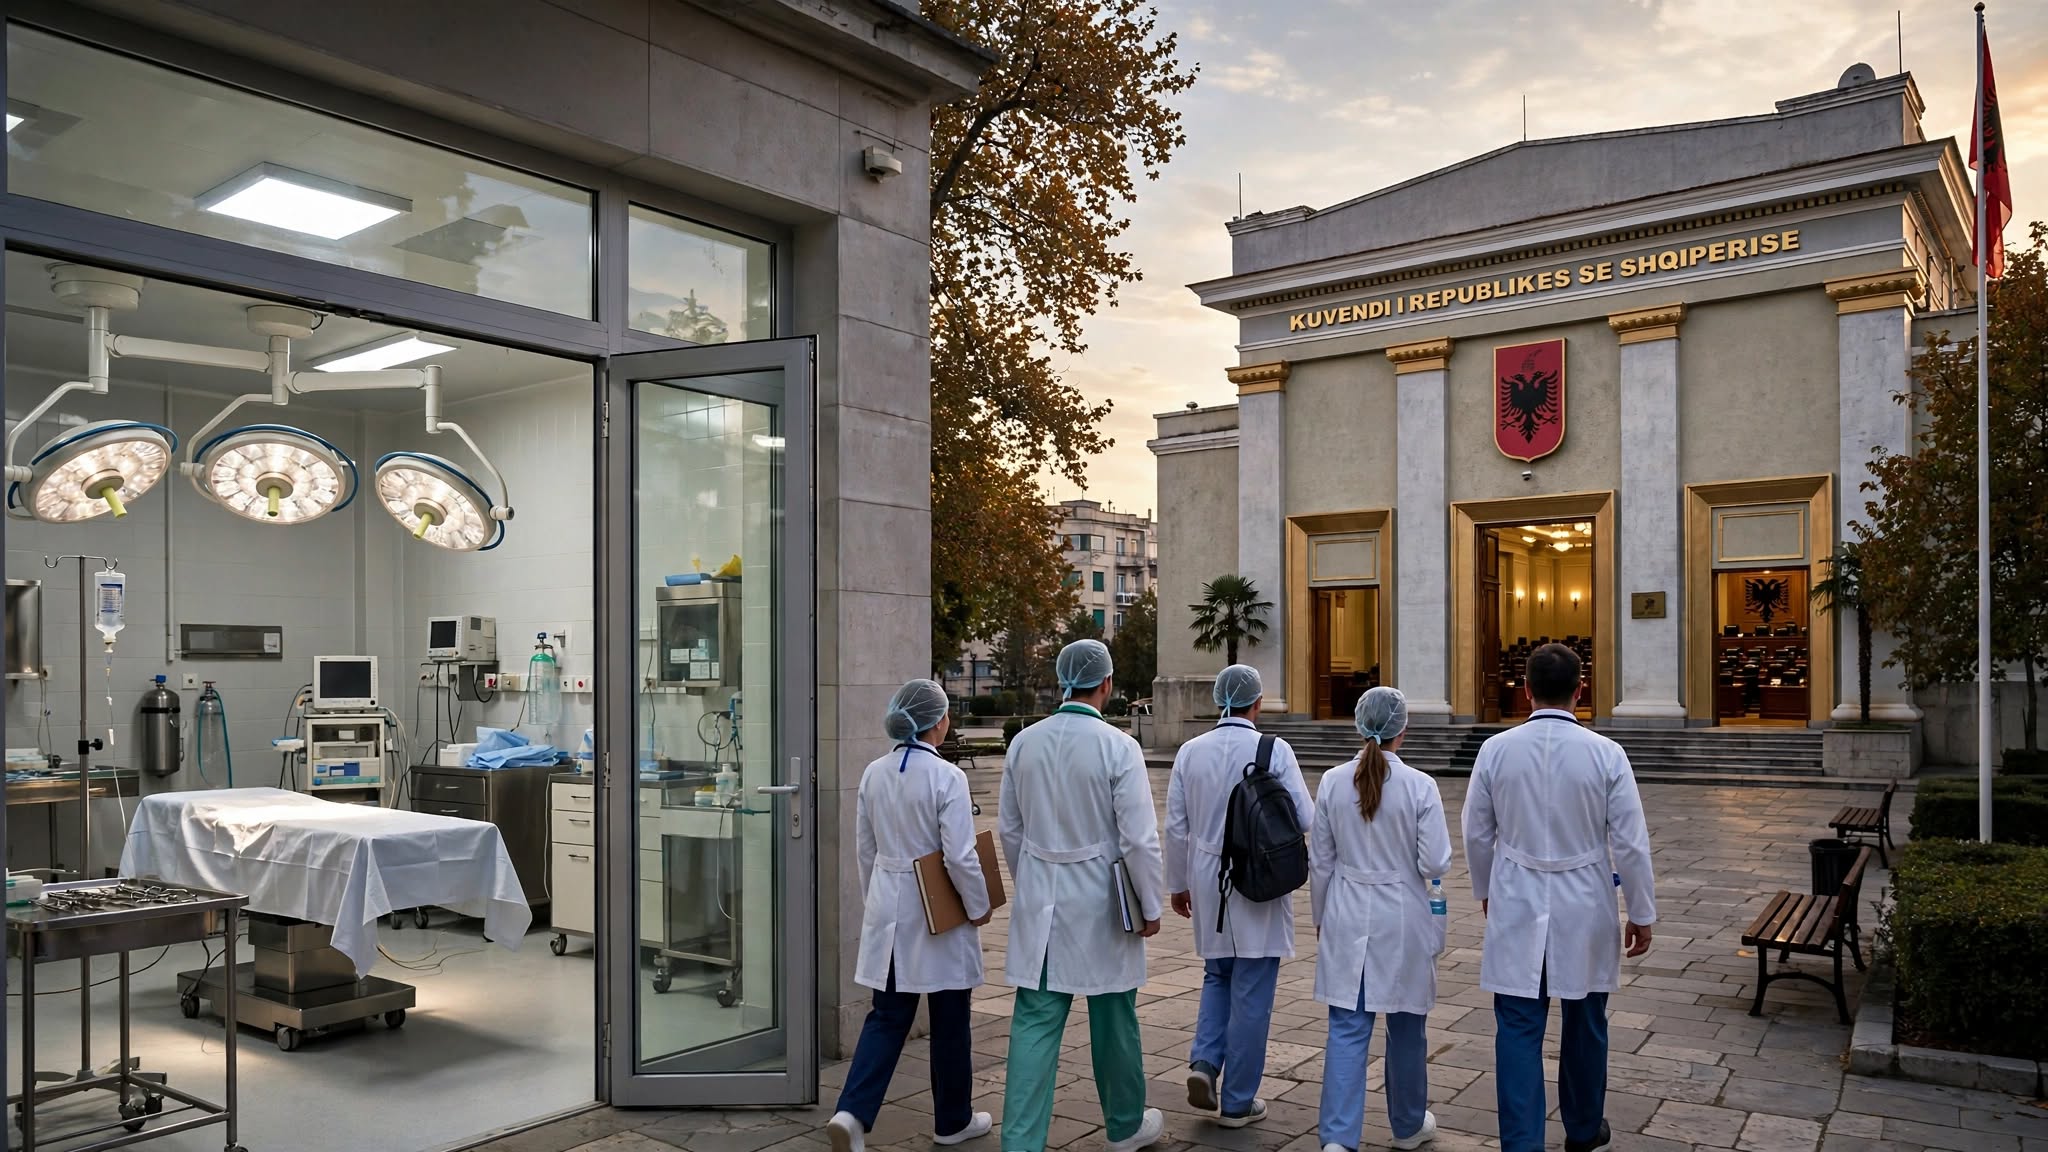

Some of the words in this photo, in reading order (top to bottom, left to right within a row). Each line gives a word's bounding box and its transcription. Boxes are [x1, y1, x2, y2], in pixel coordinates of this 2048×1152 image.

[1289, 300, 1391, 331] KUVENDI
[1397, 296, 1405, 312] I
[1409, 268, 1571, 311] REPUBLIKES
[1578, 261, 1612, 284] SE
[1620, 229, 1800, 277] SHQIPERISE
